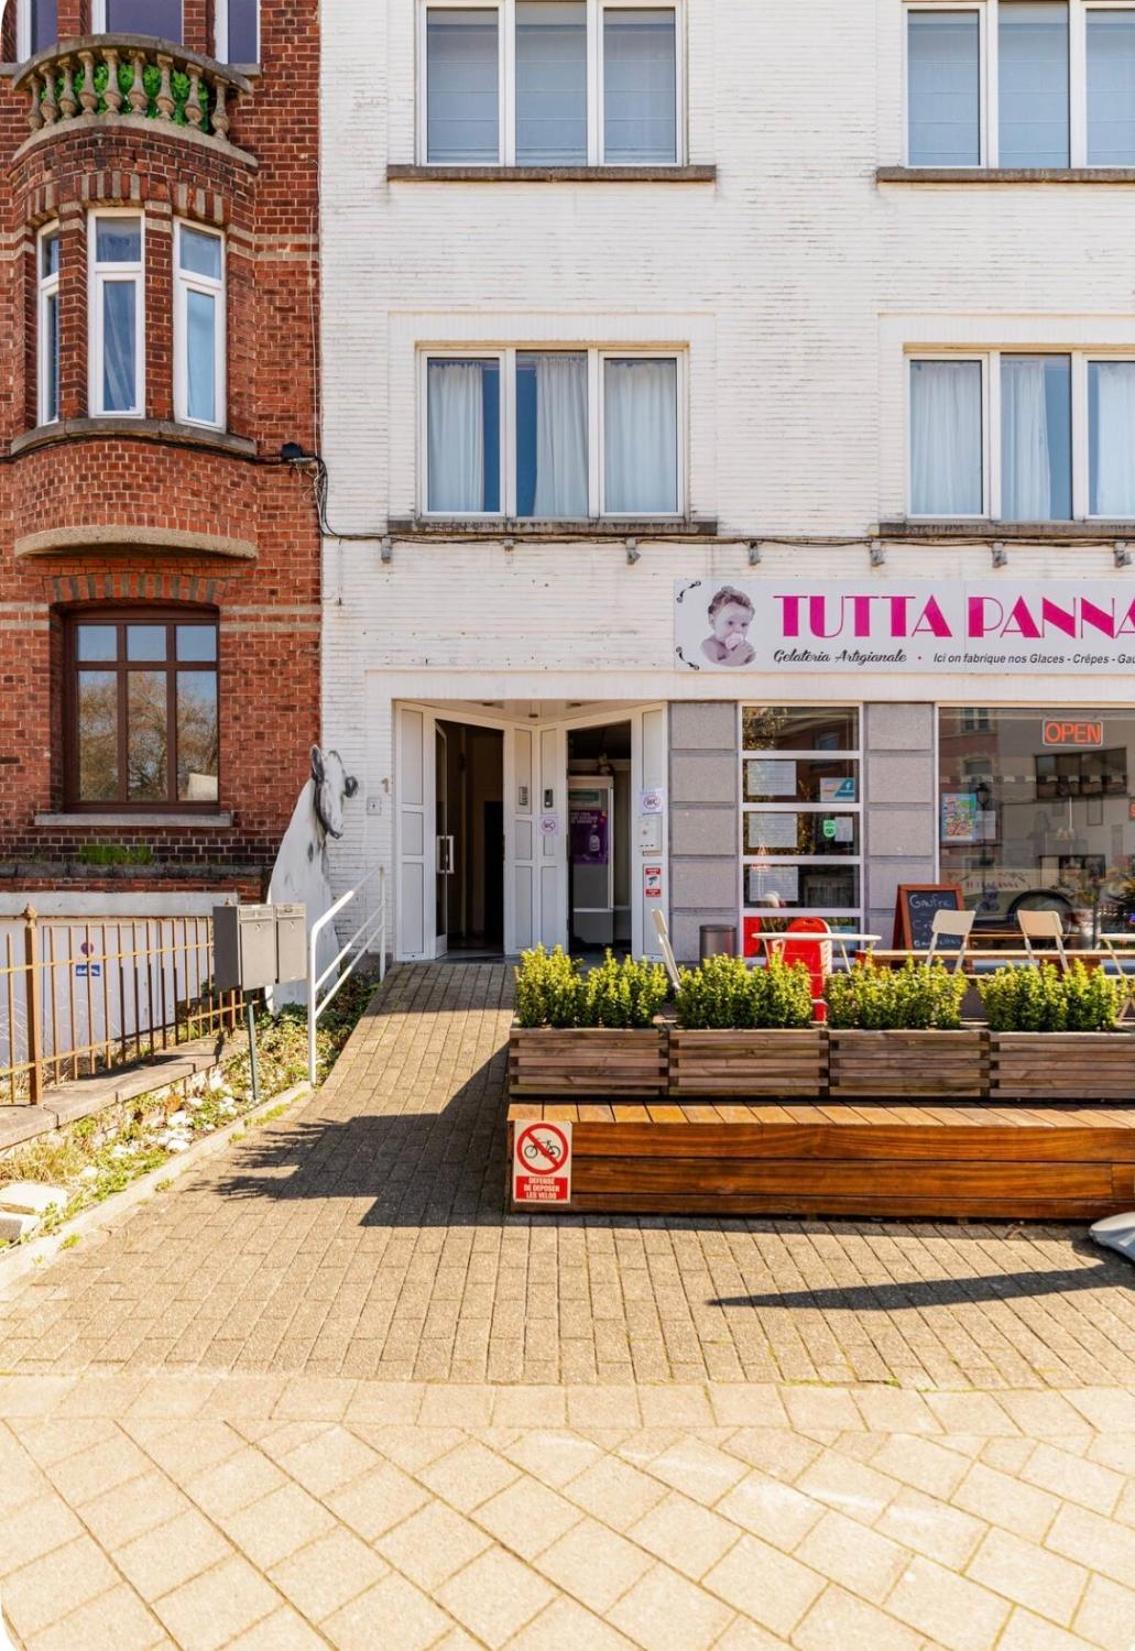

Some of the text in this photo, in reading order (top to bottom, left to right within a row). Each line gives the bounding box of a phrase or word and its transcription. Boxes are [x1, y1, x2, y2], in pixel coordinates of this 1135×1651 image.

[773, 595, 953, 638] TUTTA
[835, 649, 907, 666] Artigianale
[933, 653, 946, 663] Ici
[947, 655, 962, 663] on
[963, 653, 1006, 665] fabrique
[1007, 655, 1027, 664] nos
[1029, 653, 1065, 664] Glaces
[1045, 722, 1101, 745] OPEN
